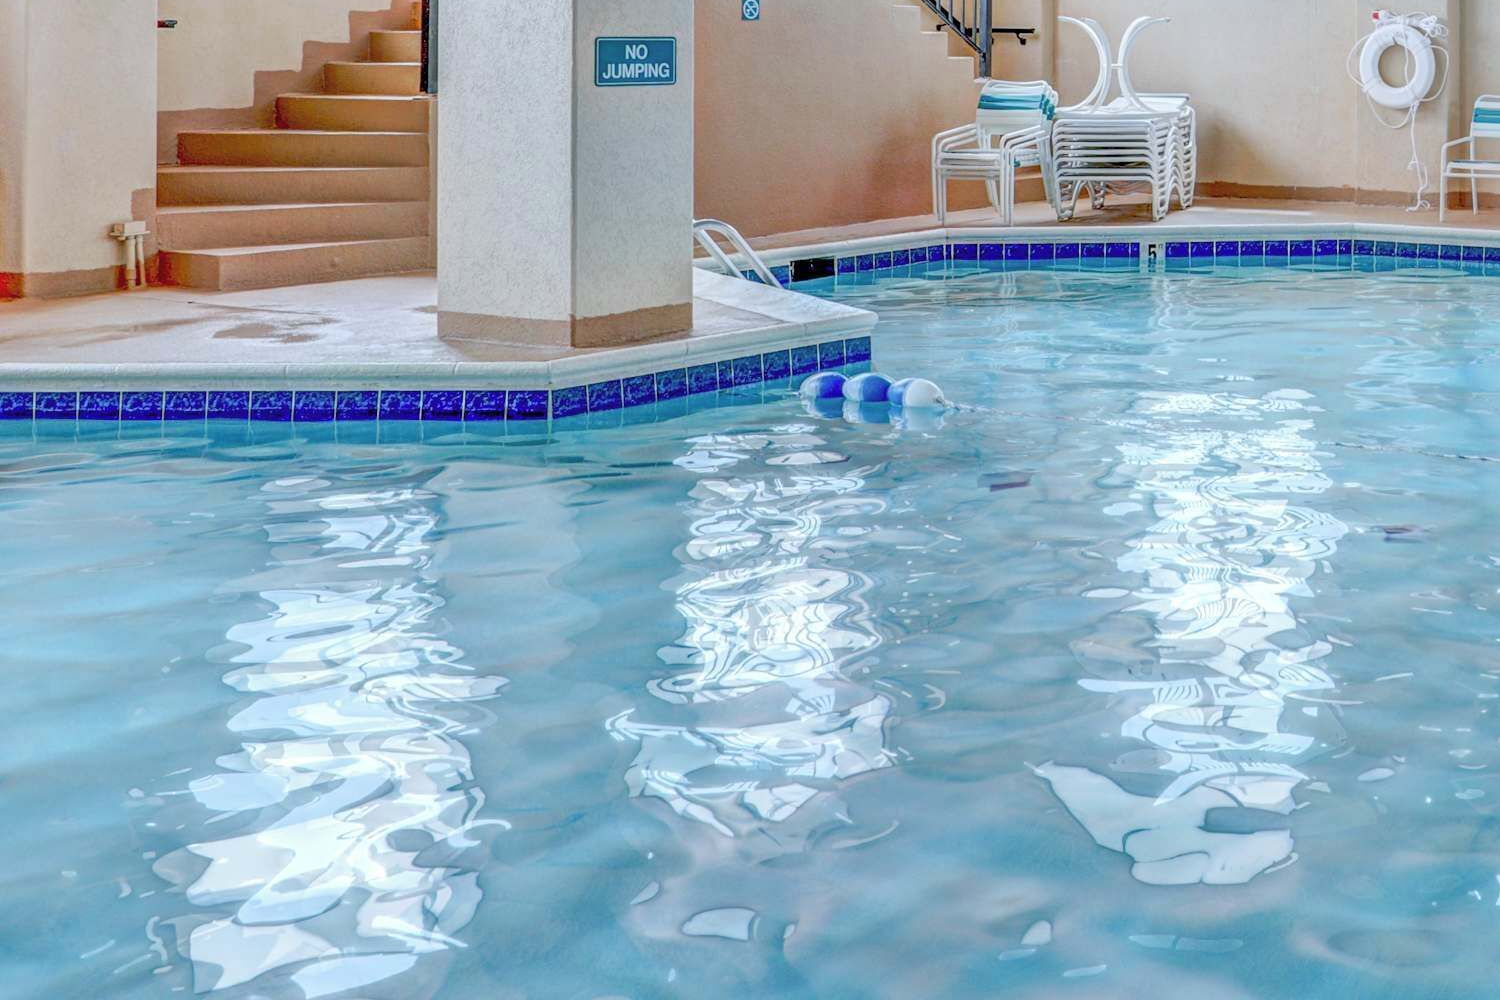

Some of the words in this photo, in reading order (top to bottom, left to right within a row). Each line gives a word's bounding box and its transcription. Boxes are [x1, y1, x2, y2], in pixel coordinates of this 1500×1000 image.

[625, 44, 648, 60] NO
[602, 63, 670, 79] JUMPING
[1148, 244, 1157, 262] 5
